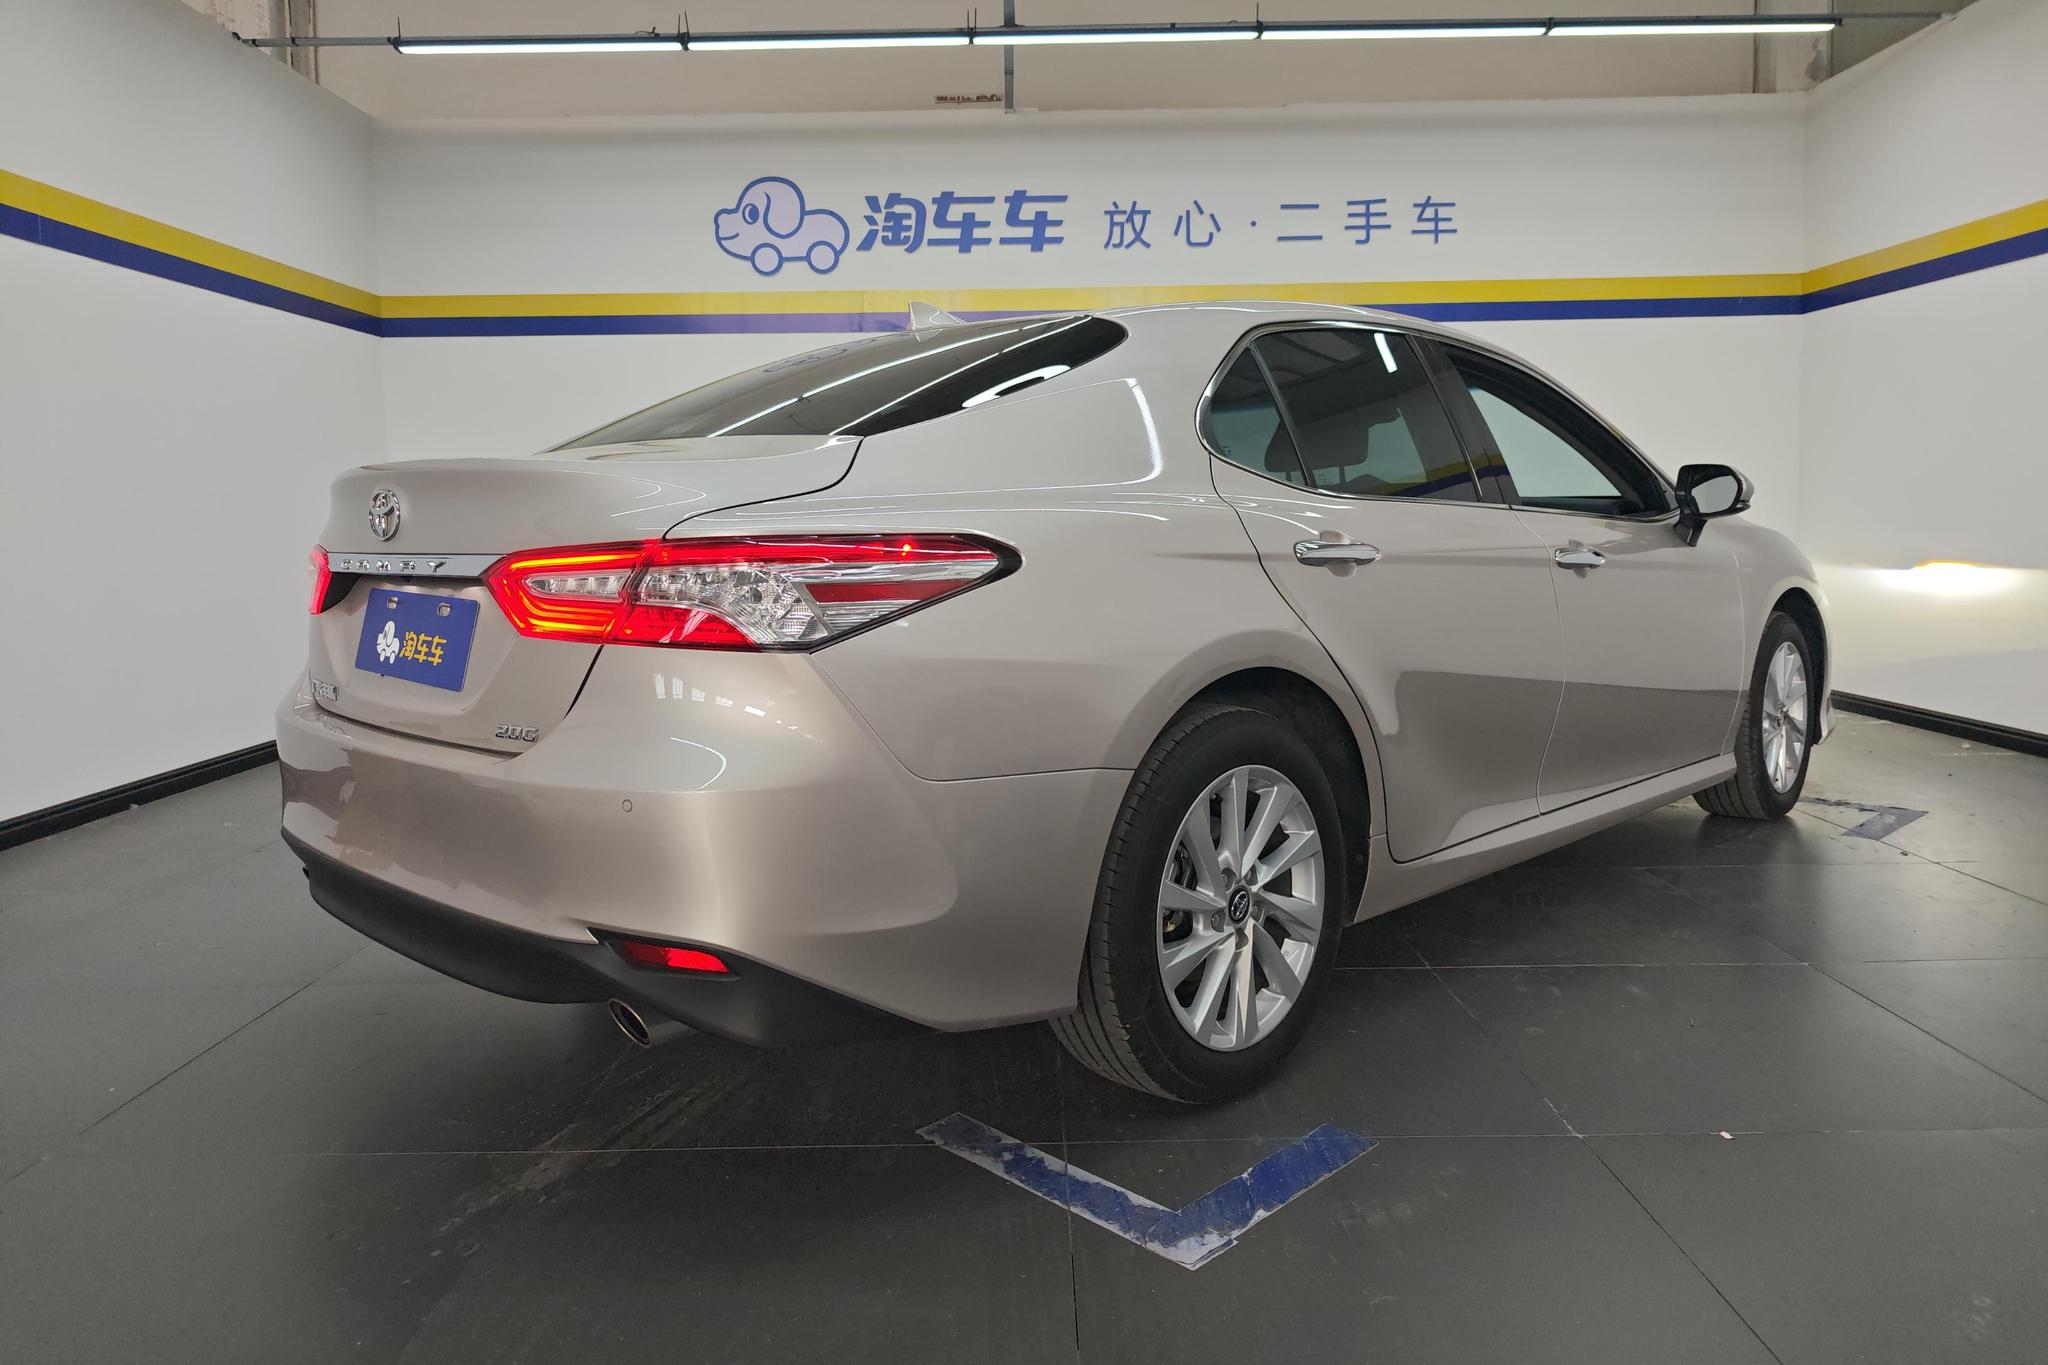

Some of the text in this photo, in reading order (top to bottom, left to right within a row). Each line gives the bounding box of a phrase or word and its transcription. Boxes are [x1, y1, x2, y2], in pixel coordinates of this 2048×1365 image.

[856, 190, 1069, 254] 淘车车
[340, 559, 447, 573] CAMRY
[399, 631, 447, 666] 淘车车
